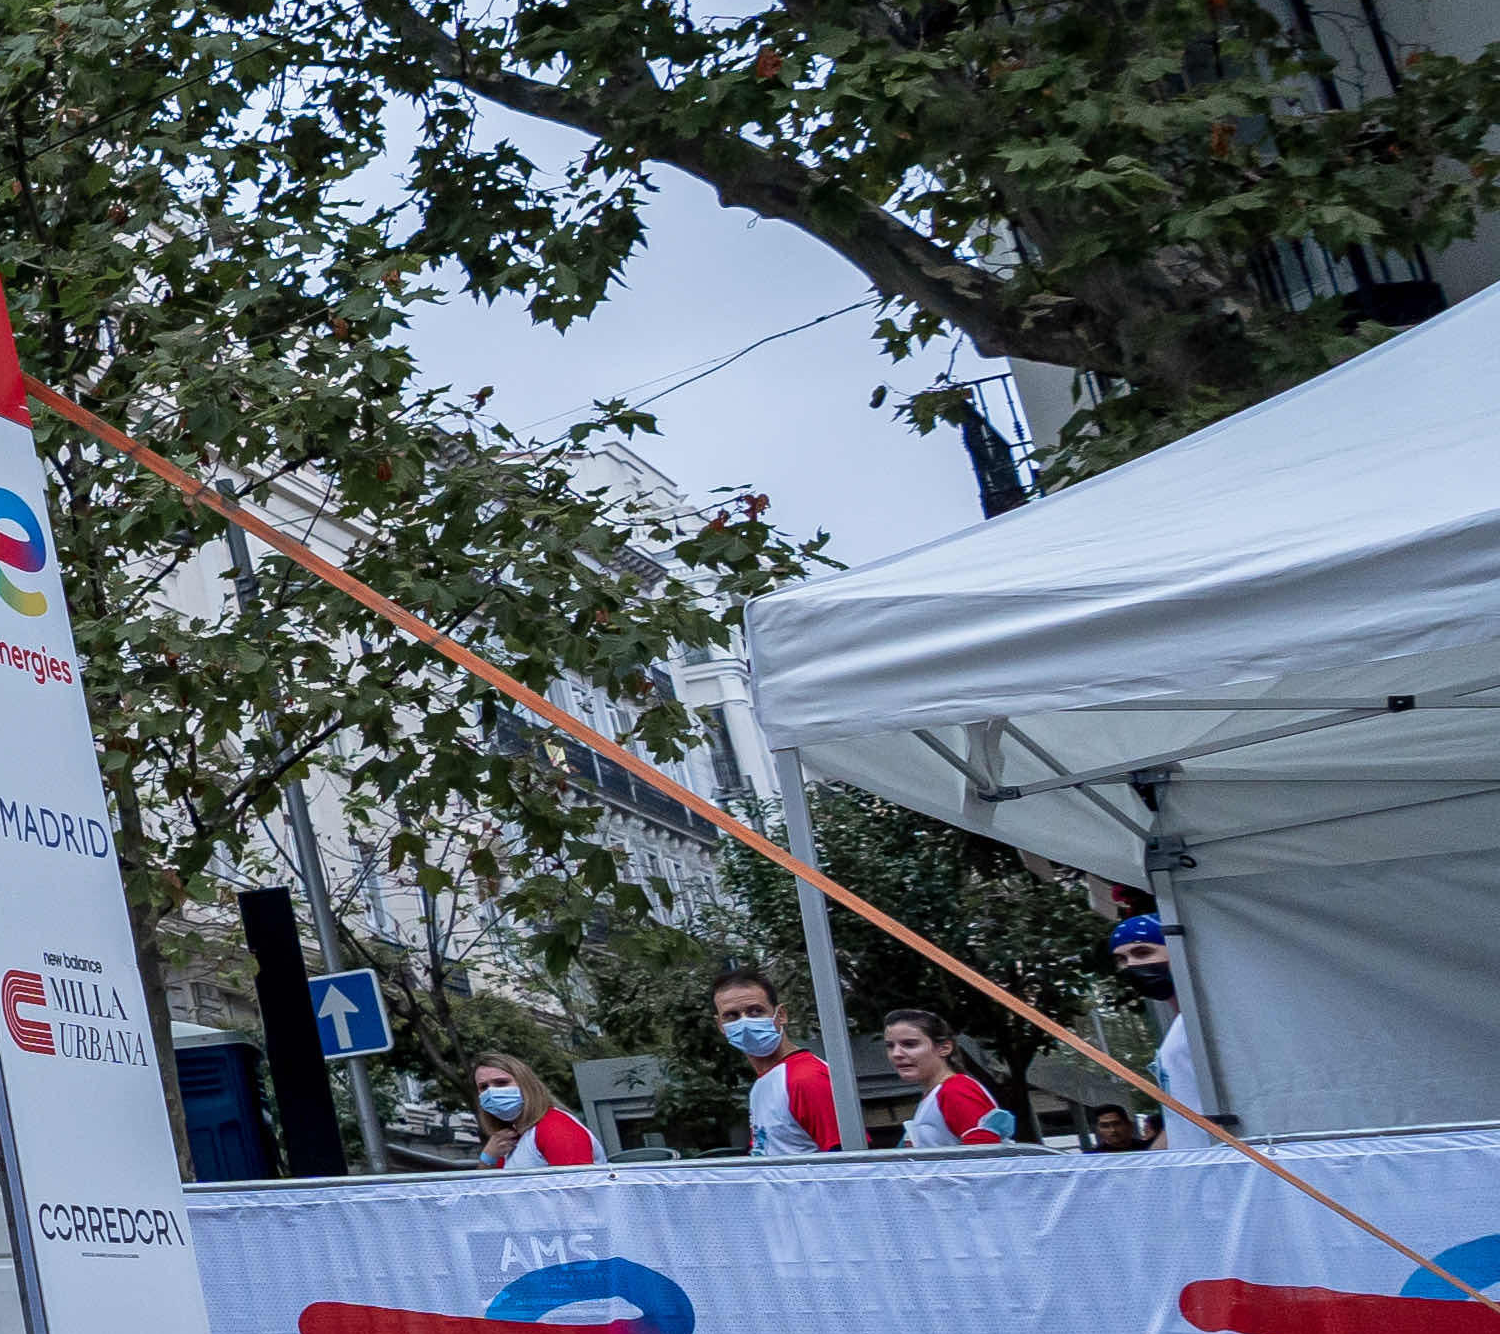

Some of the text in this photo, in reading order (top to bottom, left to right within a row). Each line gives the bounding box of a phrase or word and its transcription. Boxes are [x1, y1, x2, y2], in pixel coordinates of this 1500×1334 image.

[43, 951, 103, 974] new balance
[50, 977, 129, 1021] MILLA
[59, 1022, 150, 1066] URBANA
